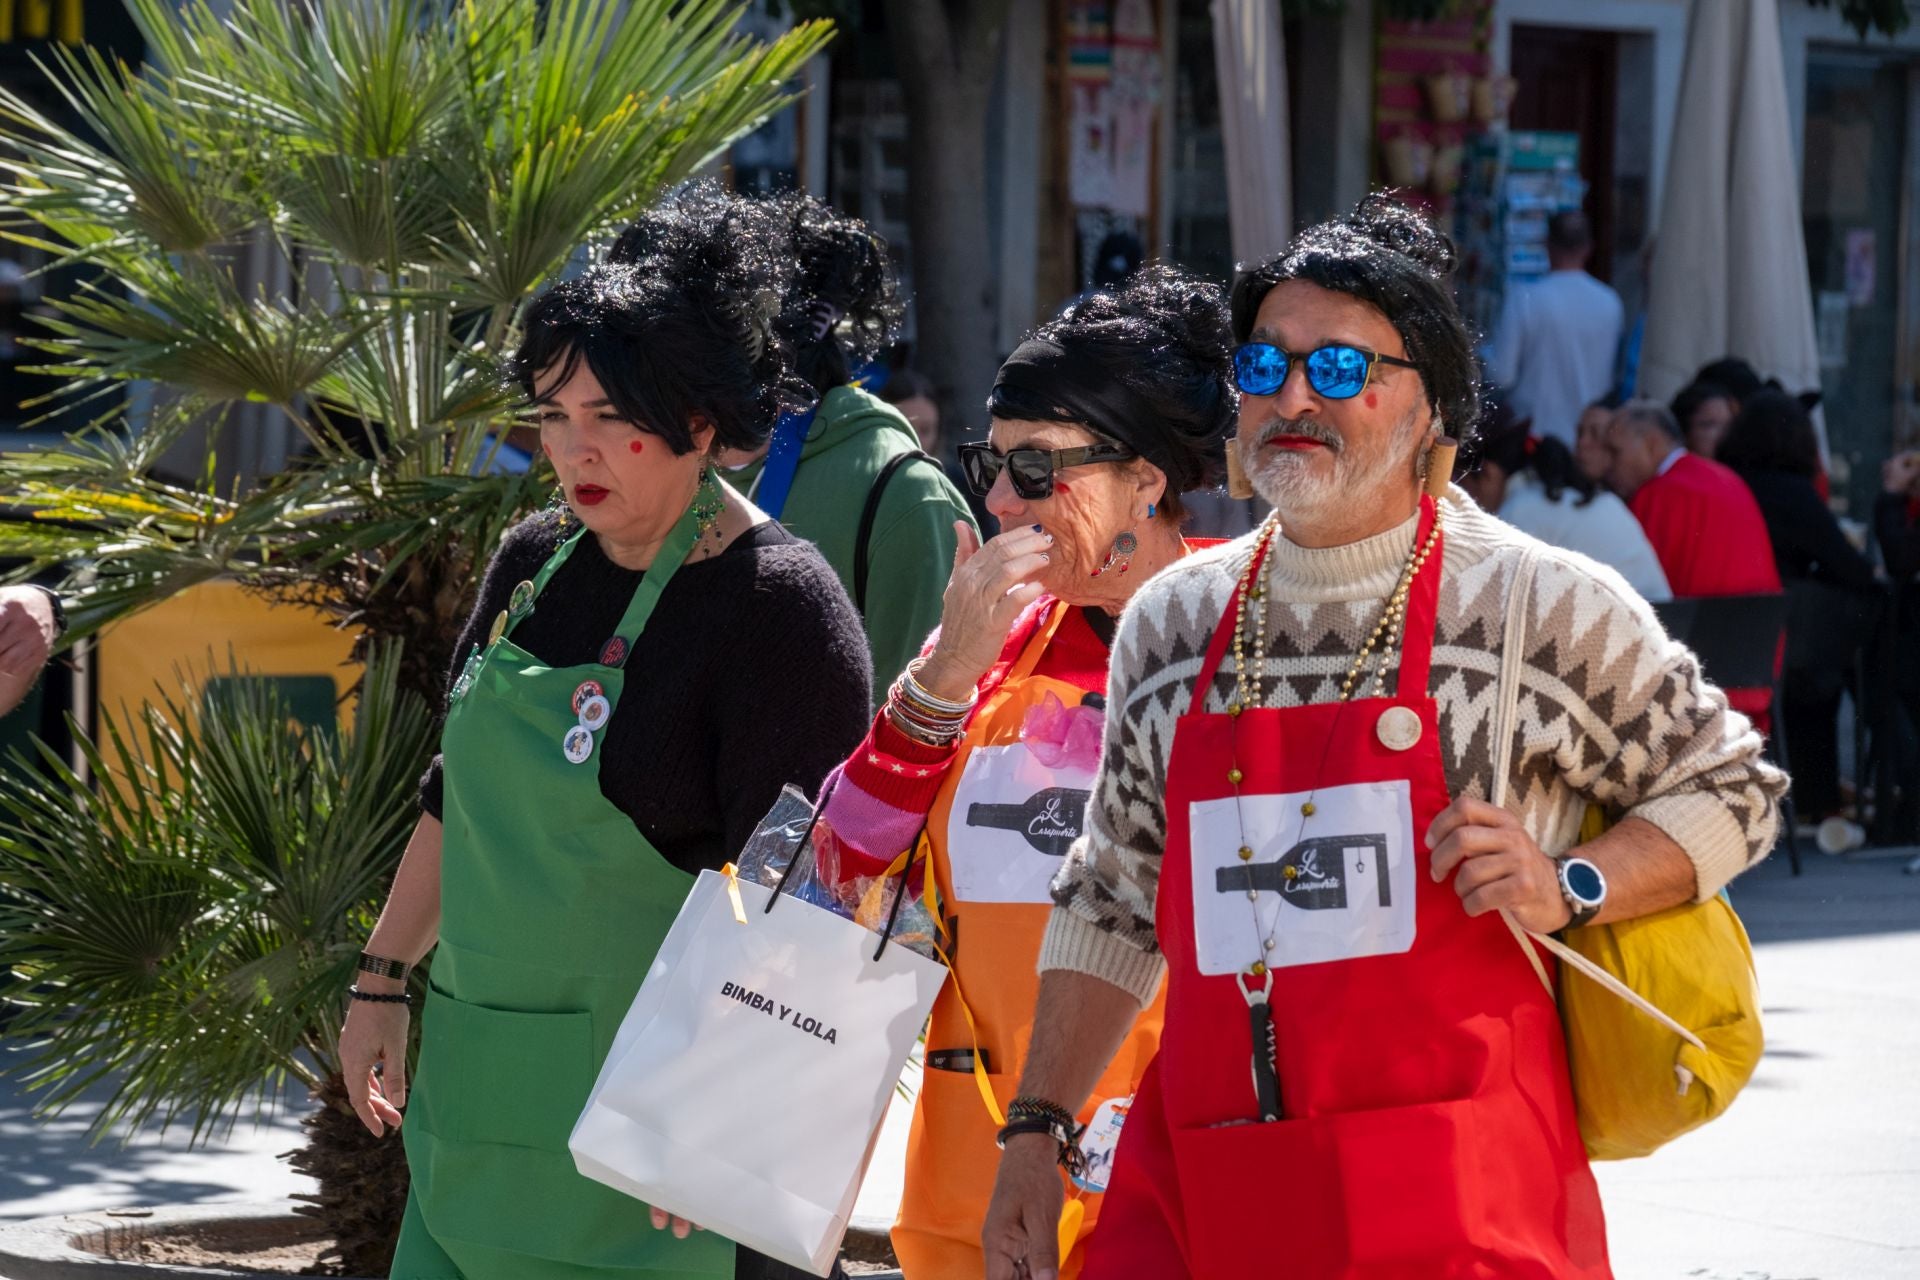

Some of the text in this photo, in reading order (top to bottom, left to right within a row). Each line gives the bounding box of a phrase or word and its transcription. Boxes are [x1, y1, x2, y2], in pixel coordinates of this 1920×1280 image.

[720, 981, 837, 1045] BIMBA Y LOLA
